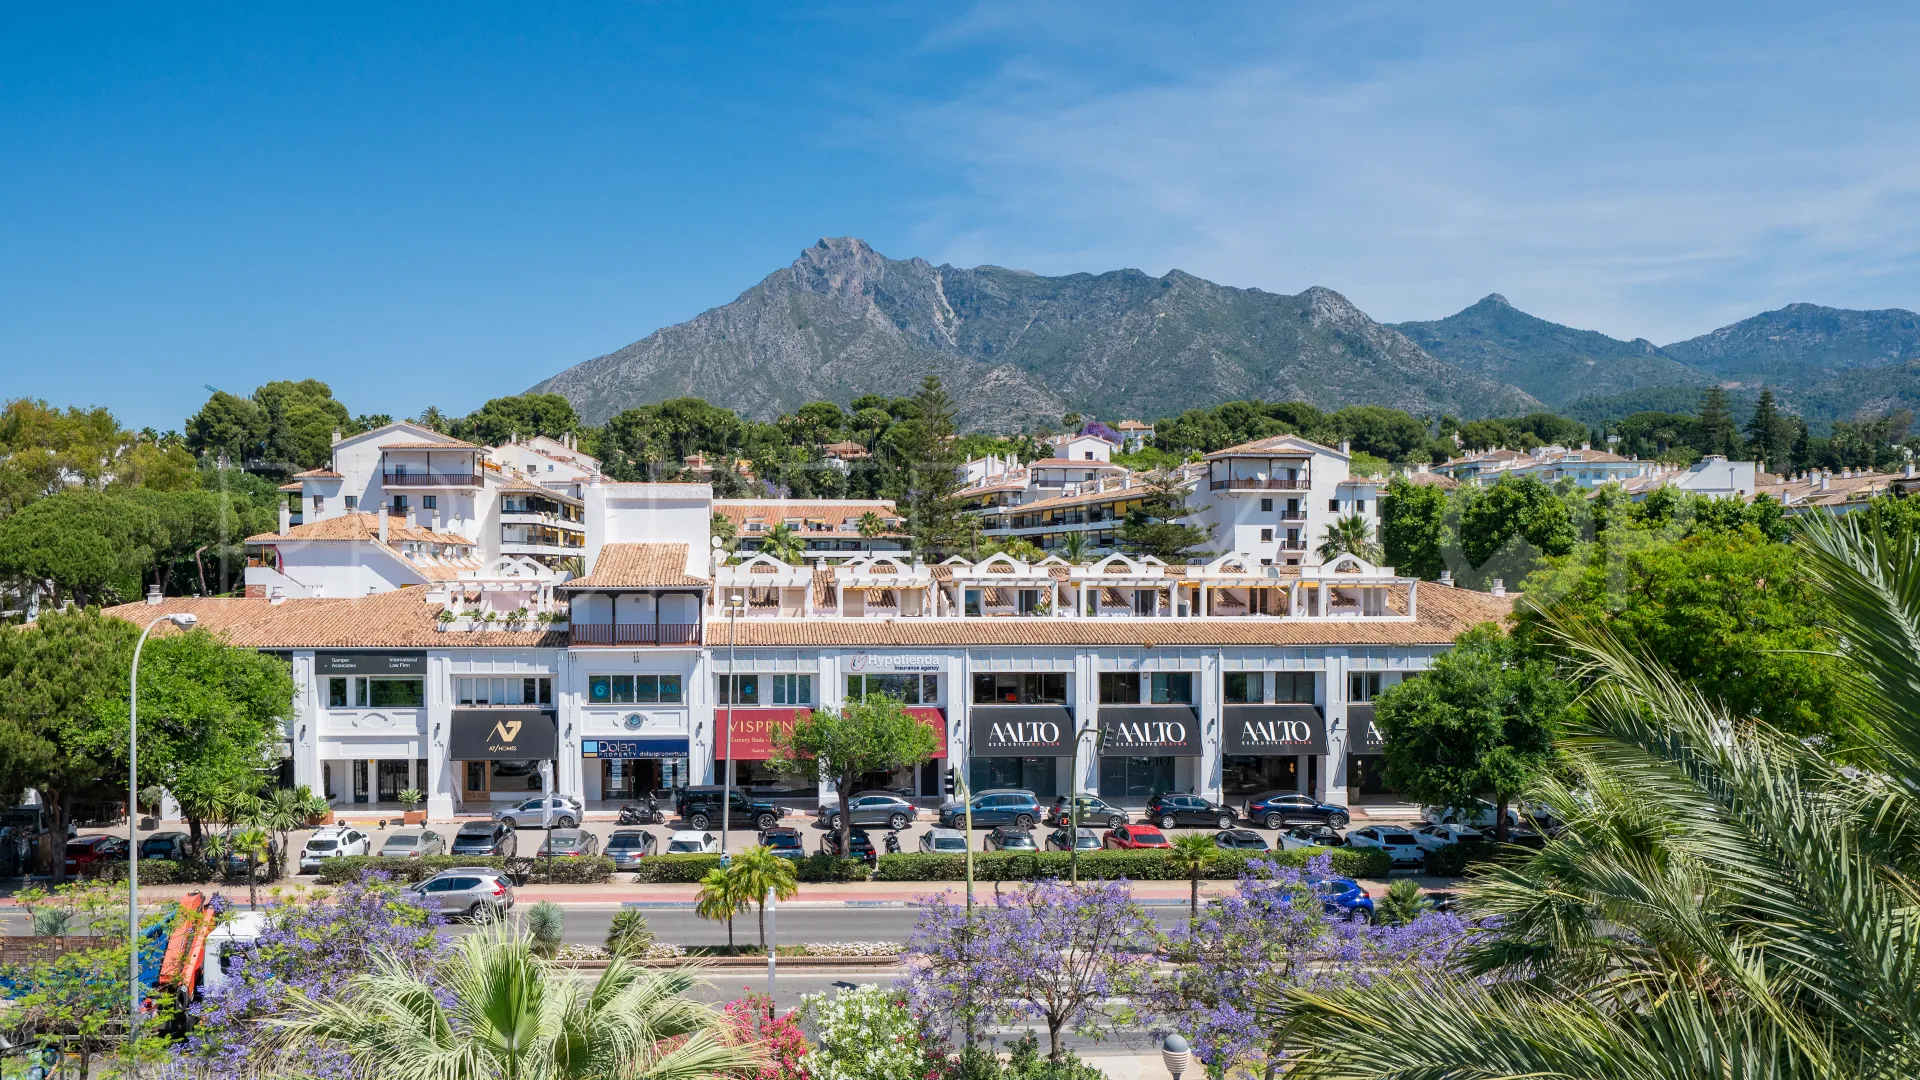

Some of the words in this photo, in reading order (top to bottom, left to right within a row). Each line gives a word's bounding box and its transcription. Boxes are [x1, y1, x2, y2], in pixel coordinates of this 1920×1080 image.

[868, 654, 940, 668] Hypotienda
[989, 721, 1060, 743] AALTO
[1116, 721, 1186, 743] AALTO
[1241, 720, 1311, 742] AALTO
[598, 741, 637, 753] Dolan
